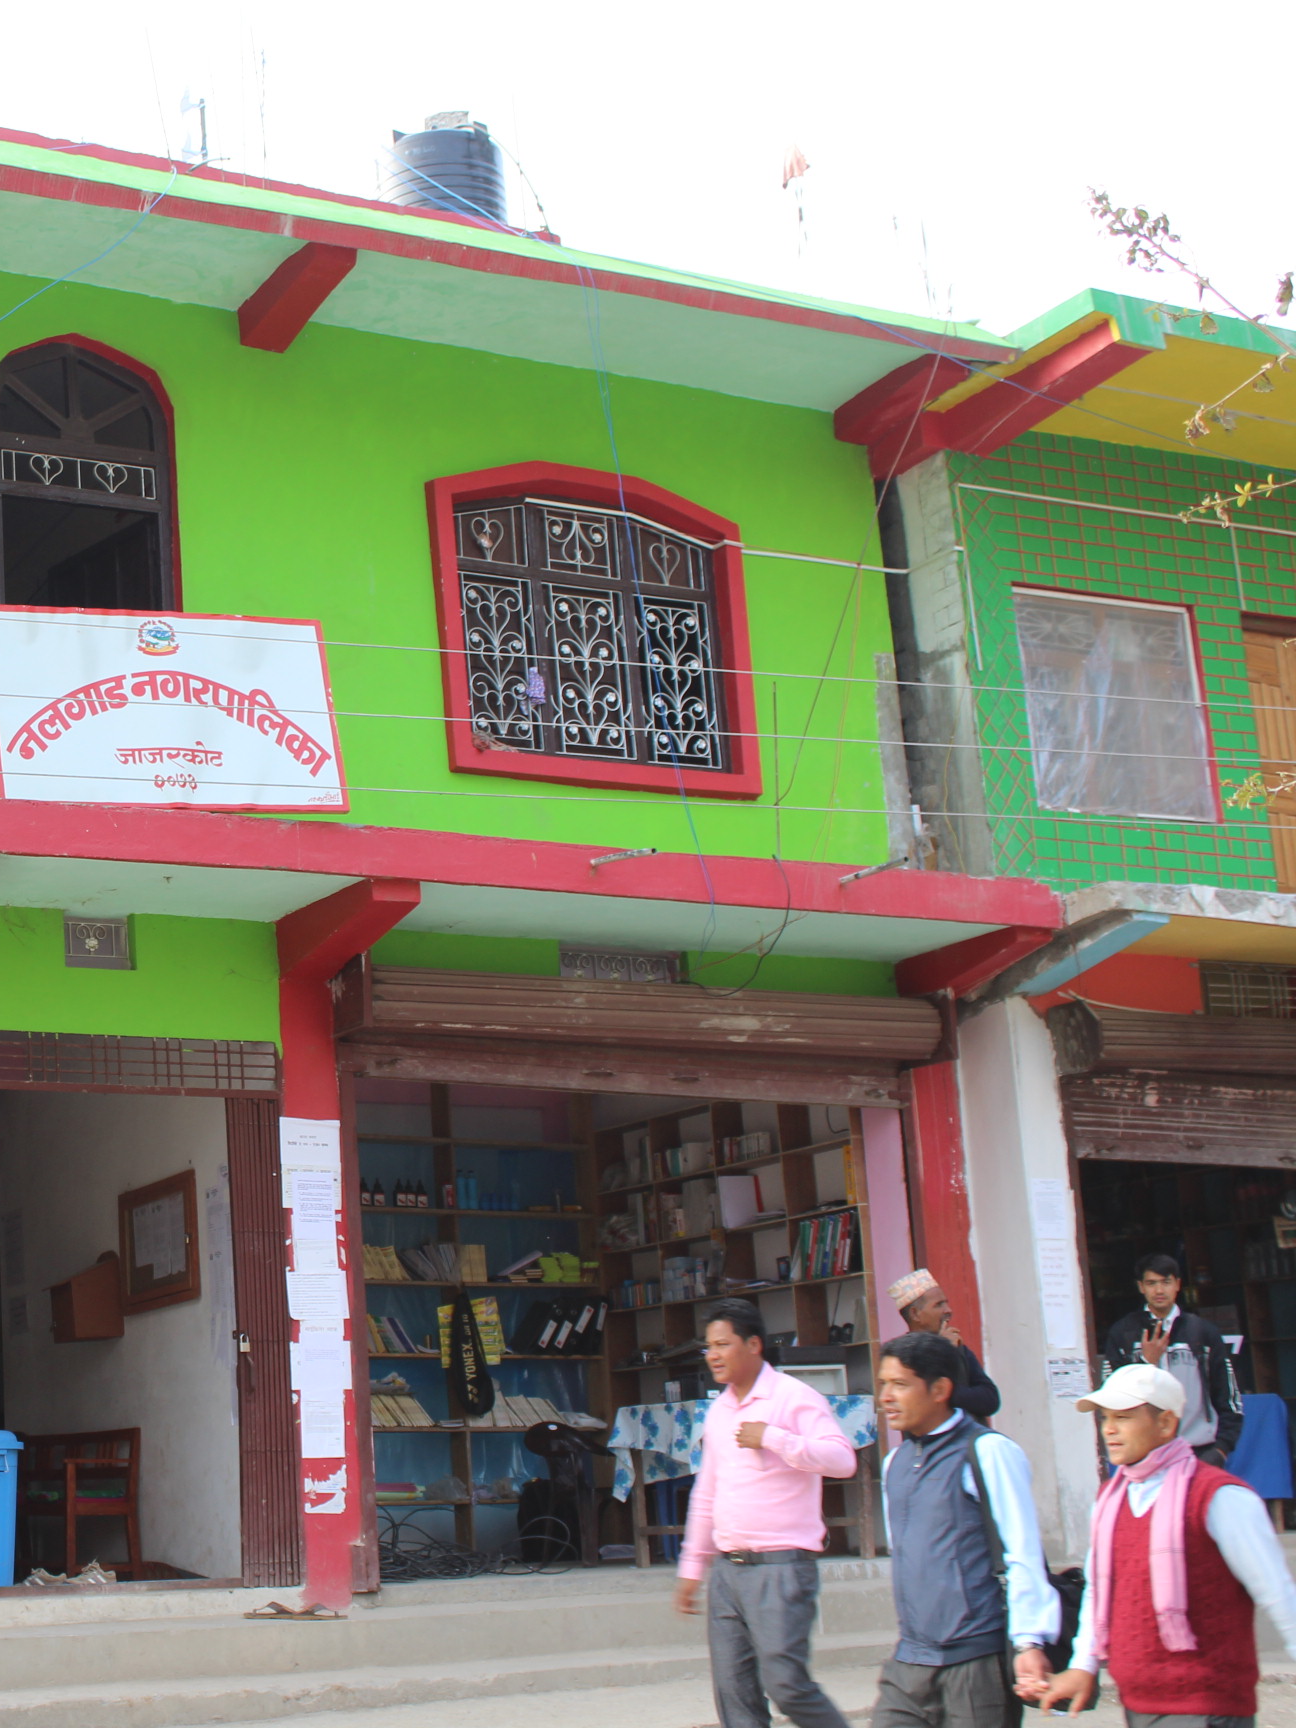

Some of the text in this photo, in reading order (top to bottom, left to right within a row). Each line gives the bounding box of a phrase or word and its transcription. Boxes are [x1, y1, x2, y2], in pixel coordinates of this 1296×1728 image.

[6, 670, 331, 777] नलगाड नगरपालिका
[114, 741, 223, 768] जाजरकोट
[462, 1343, 477, 1381] YONEX
